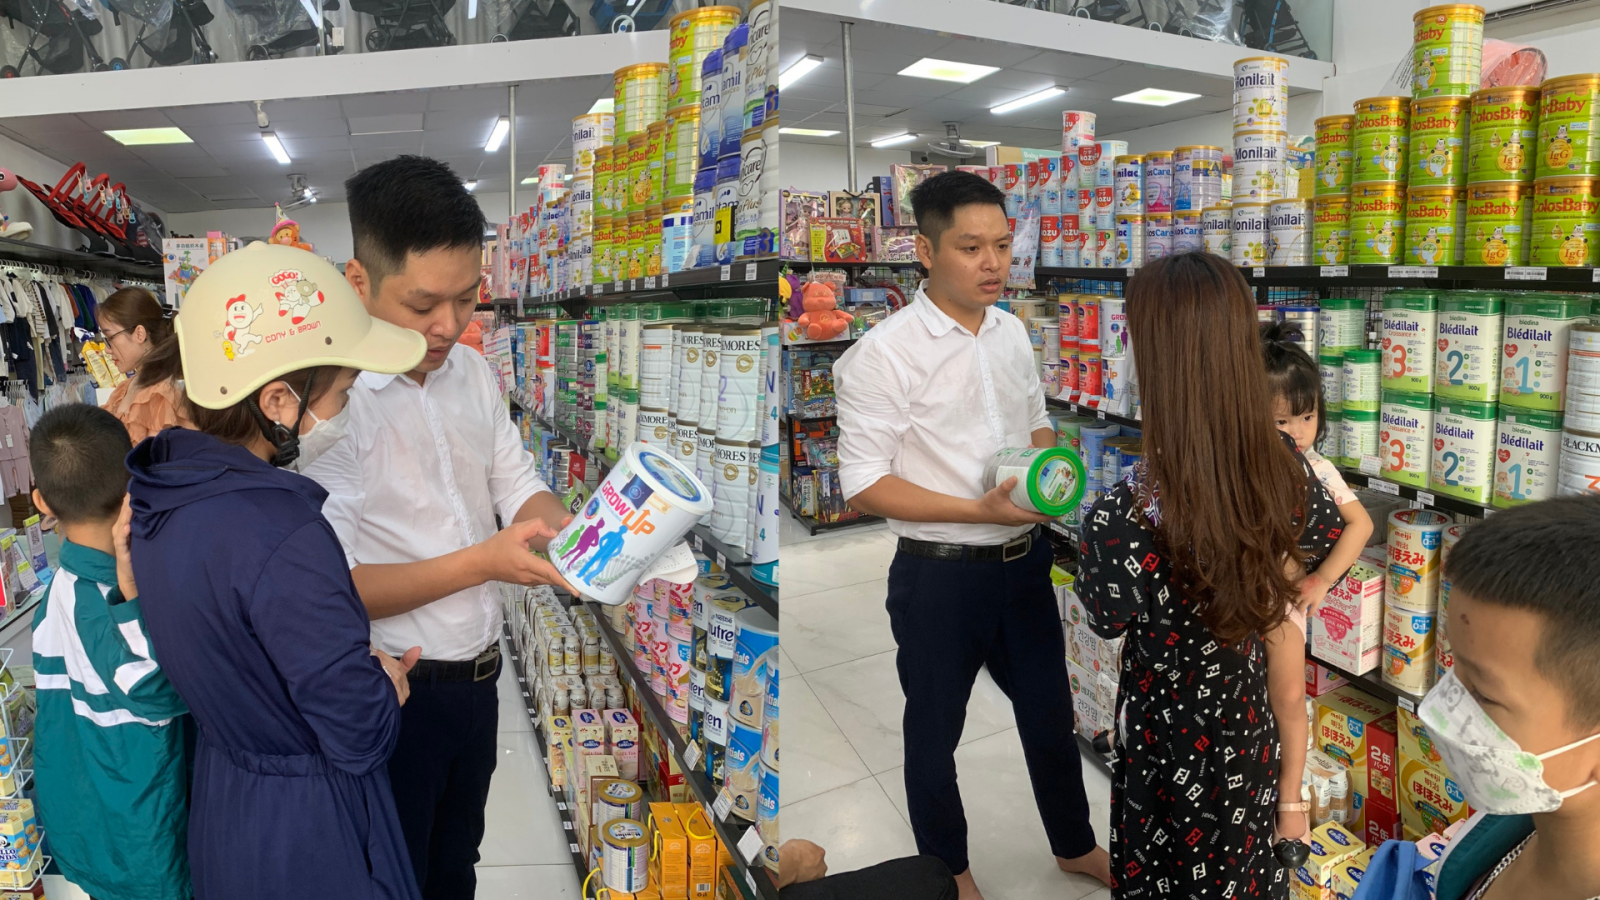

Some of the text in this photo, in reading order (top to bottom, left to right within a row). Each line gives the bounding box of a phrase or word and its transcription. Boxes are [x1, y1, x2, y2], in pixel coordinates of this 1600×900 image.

[271, 271, 299, 285] GOGO!
[265, 321, 321, 343] CONY & BROWN
[1384, 318, 1419, 331] Blédilait
[1440, 322, 1479, 336] Blédilait
[1507, 326, 1553, 341] Blédilait
[1391, 344, 1407, 378] 3
[1447, 350, 1464, 385] 2
[1515, 356, 1534, 394] 1
[770, 406, 778, 420] 4
[1383, 412, 1419, 428] Blédilait
[1435, 422, 1475, 440] Blédilait
[1500, 432, 1544, 451] Blédilait
[1389, 439, 1405, 472] 3
[1442, 451, 1459, 486] 2
[1508, 463, 1525, 500] 1
[602, 480, 631, 516] GROW
[622, 509, 656, 535] UP
[760, 528, 766, 541] 4
[1077, 628, 1097, 651] 건강맘
[1322, 725, 1355, 749] ほほえみ
[1413, 781, 1453, 813] ほほえみ
